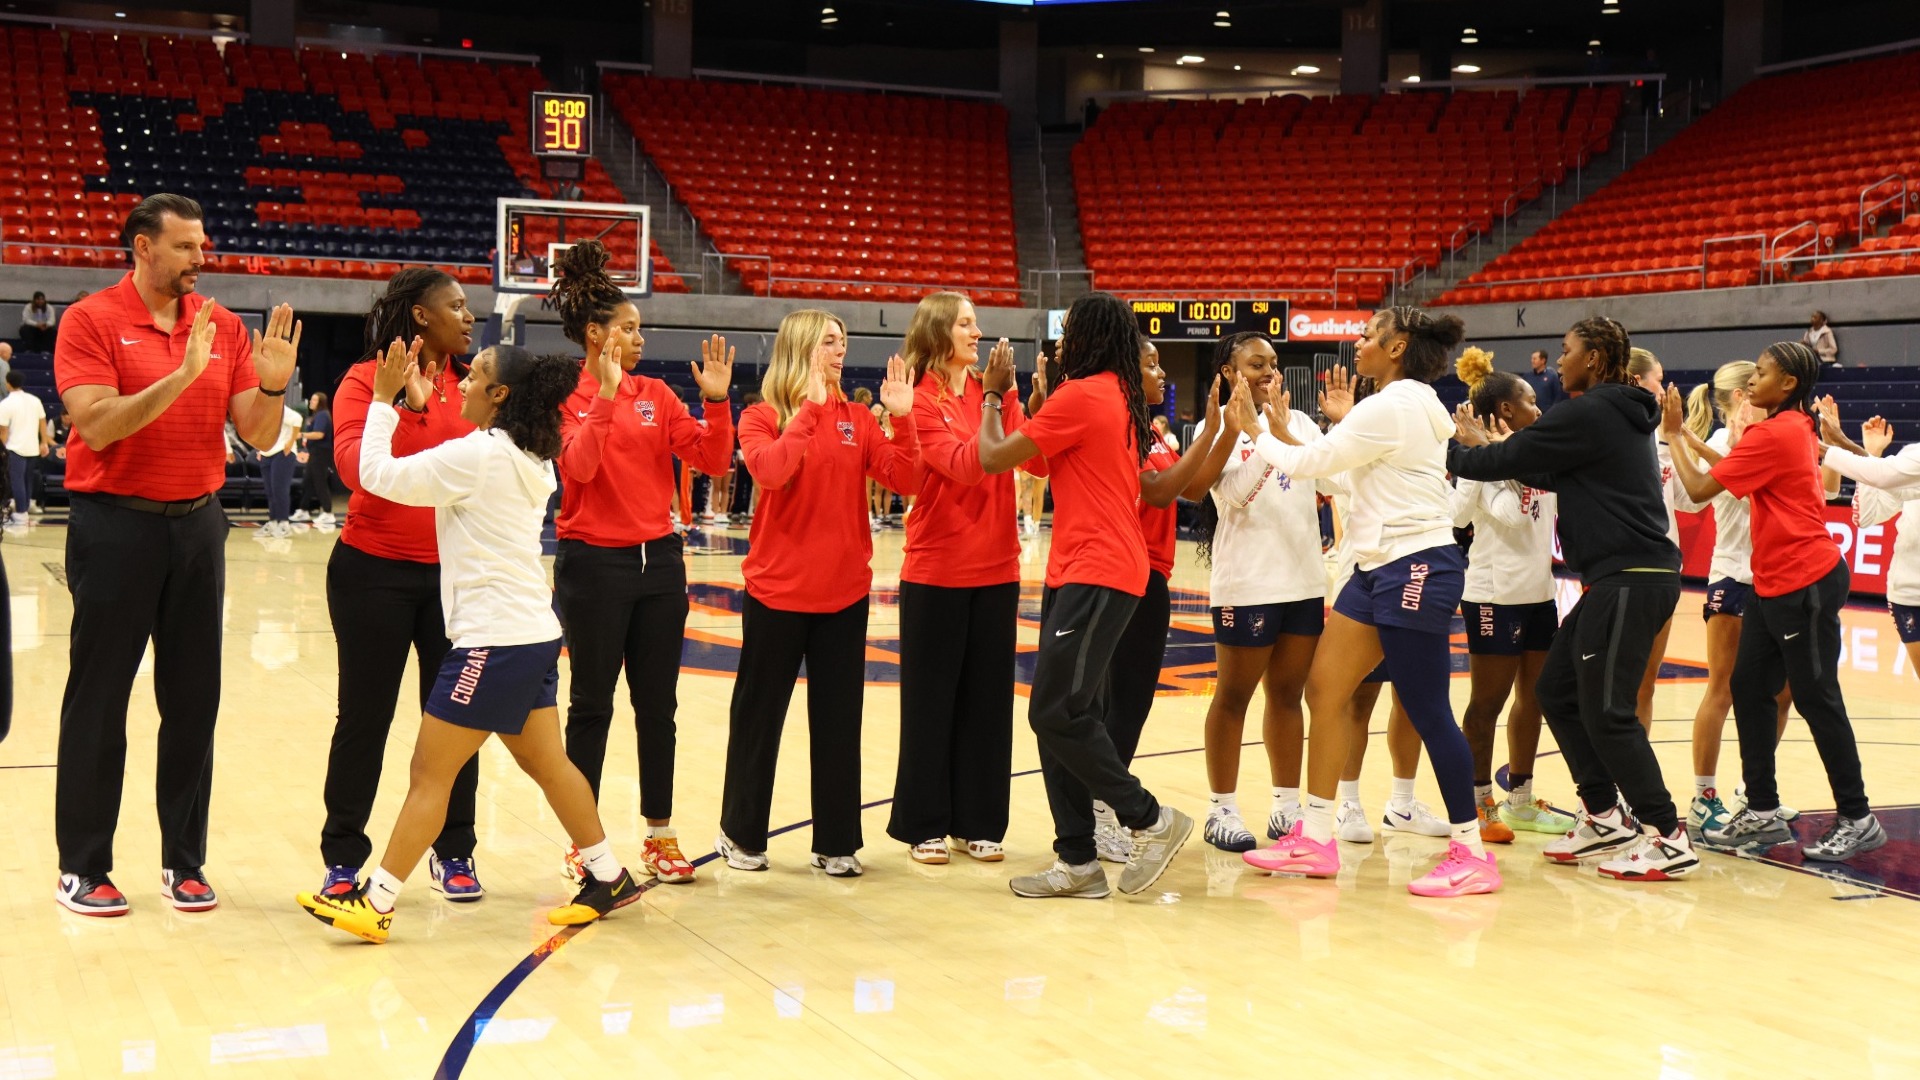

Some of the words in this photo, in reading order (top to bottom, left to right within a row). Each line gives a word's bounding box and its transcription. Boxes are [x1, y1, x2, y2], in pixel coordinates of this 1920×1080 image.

[1349, 14, 1376, 31] 114
[544, 99, 586, 118] 10:00
[544, 118, 581, 149] 30
[1132, 302, 1176, 313] AUBURN
[1189, 302, 1232, 321] 10:00
[1252, 302, 1269, 313] CSU
[879, 309, 888, 327] L
[1150, 317, 1161, 335] 0
[1269, 317, 1281, 335] 0
[1517, 307, 1526, 328] K
[1186, 327, 1210, 336] PERIOD
[1215, 325, 1221, 335] 1
